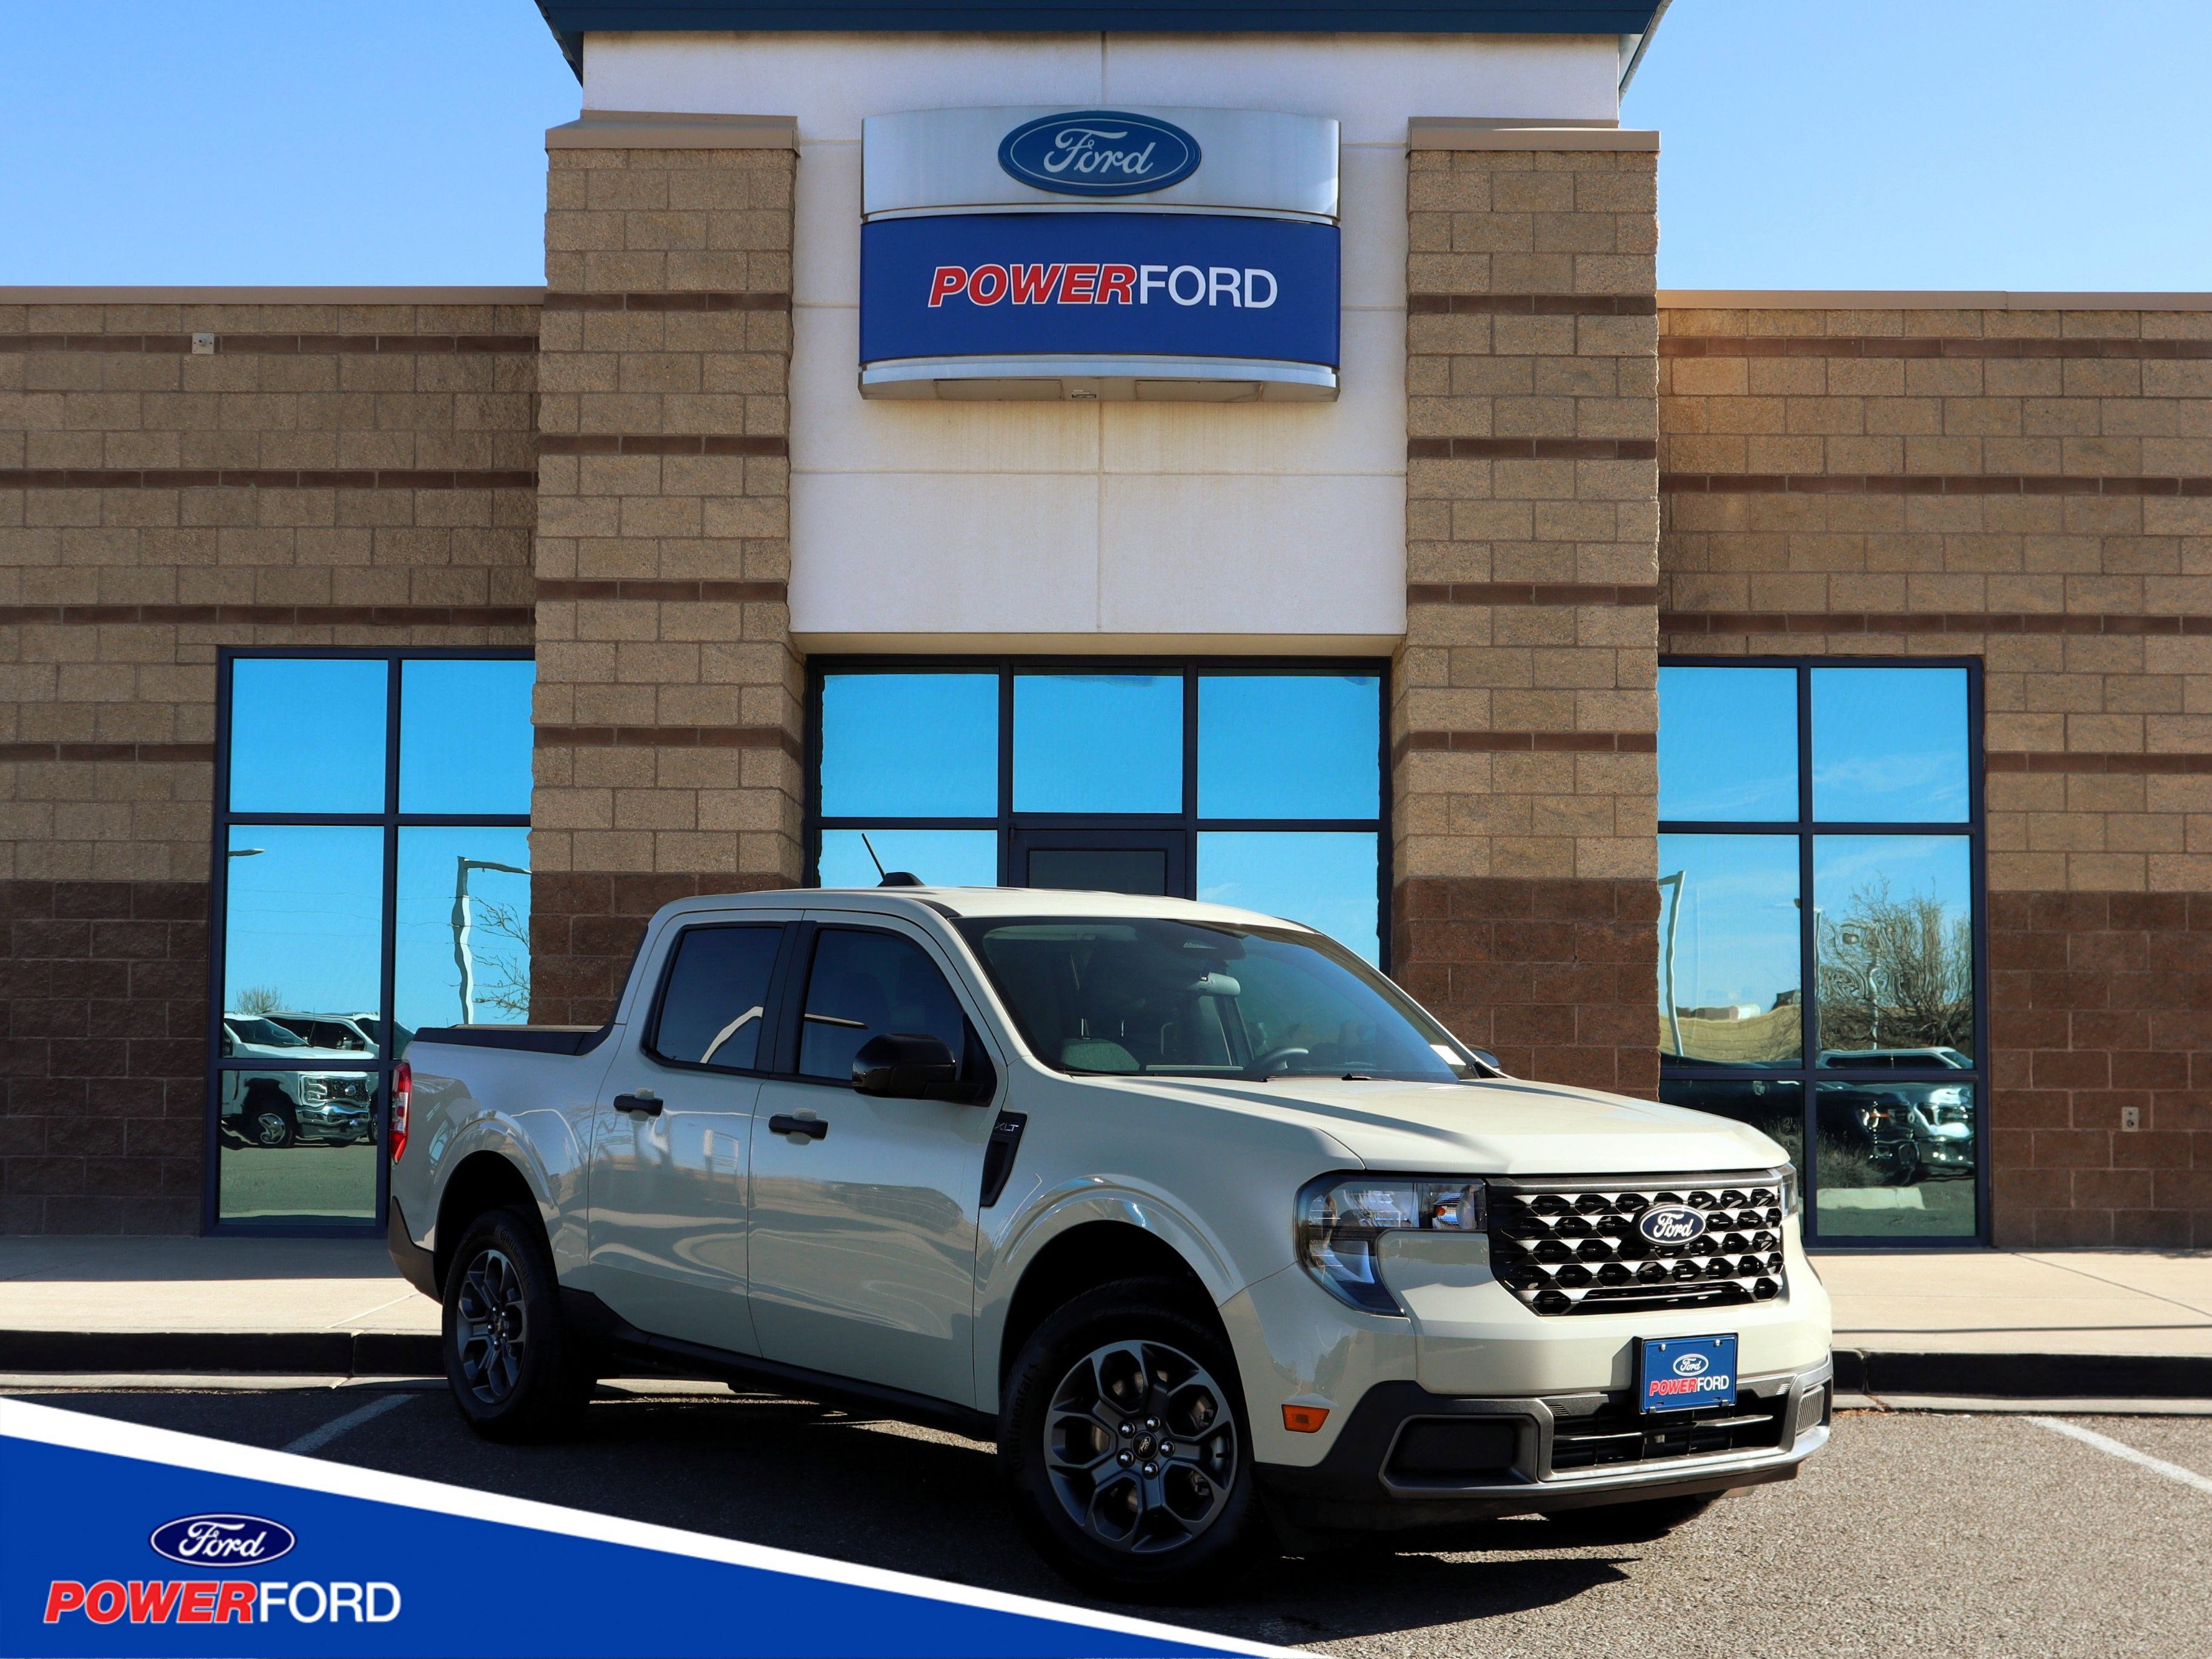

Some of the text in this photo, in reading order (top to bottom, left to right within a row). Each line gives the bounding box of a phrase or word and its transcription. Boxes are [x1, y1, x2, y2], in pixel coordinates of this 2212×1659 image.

[1043, 127, 1155, 174] Ford
[994, 1122, 1020, 1132] XLT
[1653, 1212, 1694, 1238] Ford
[1679, 1358, 1702, 1372] Ford
